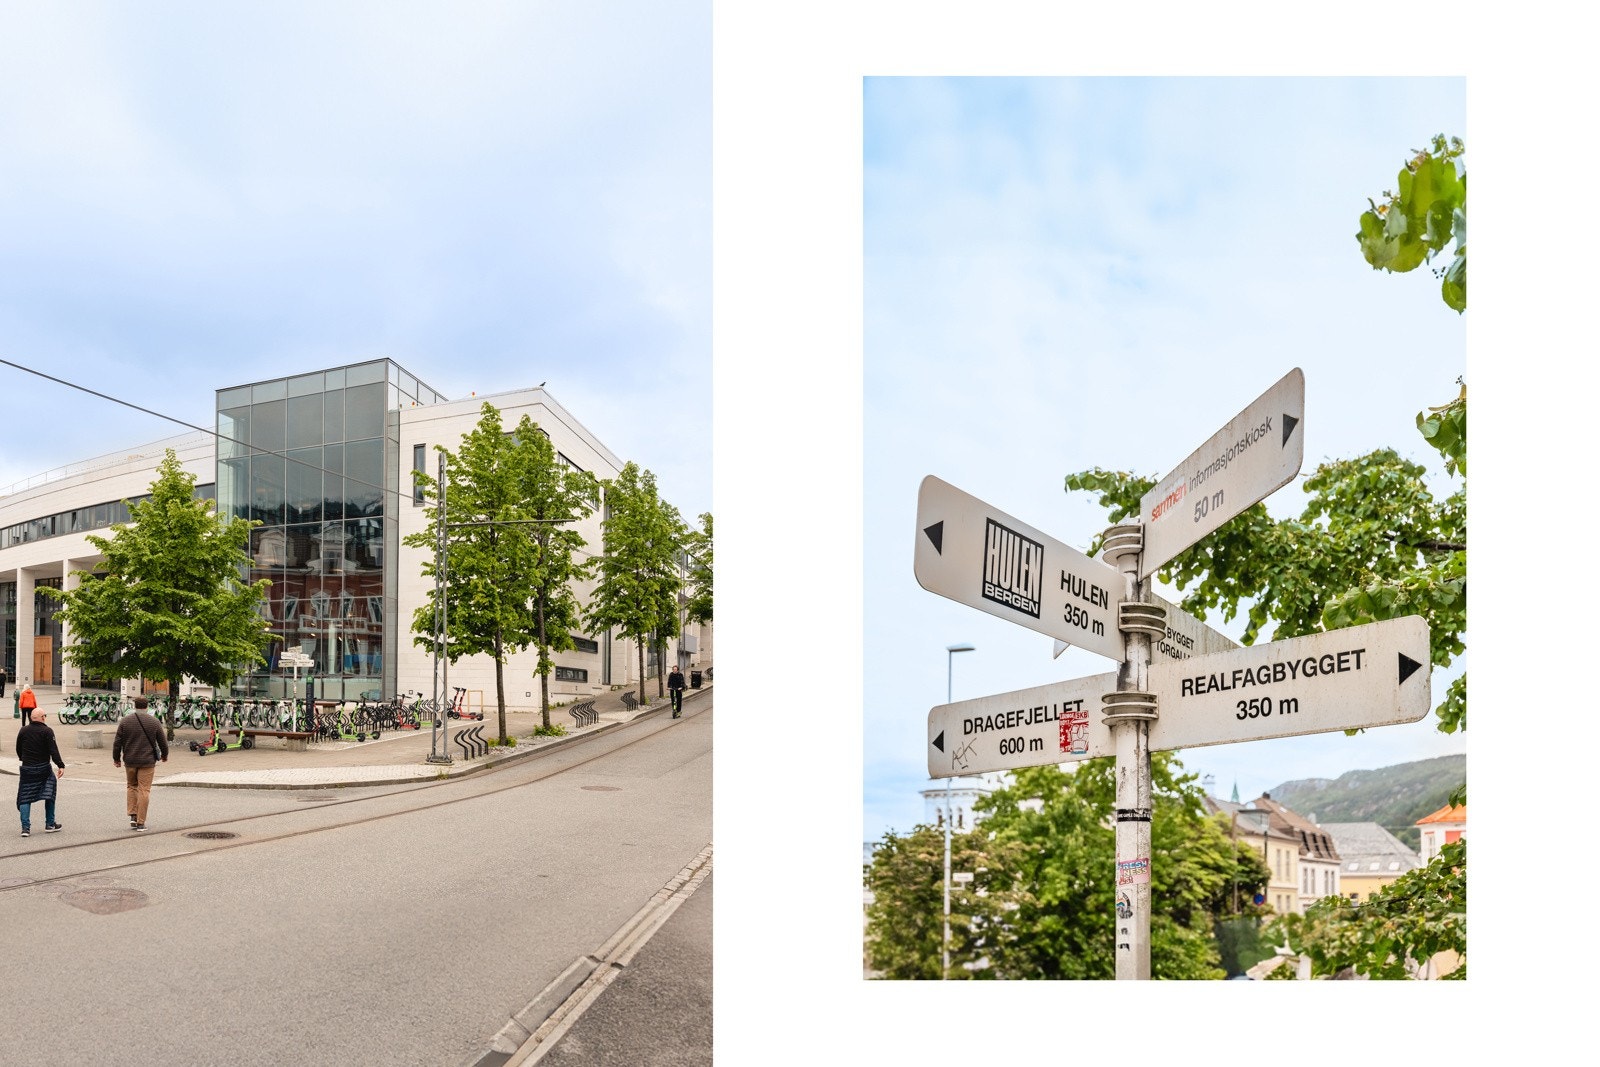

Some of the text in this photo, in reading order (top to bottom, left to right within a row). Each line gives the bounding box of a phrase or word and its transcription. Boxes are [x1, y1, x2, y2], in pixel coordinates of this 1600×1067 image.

[1151, 416, 1273, 522] sammen informasjonskiosk
[1193, 489, 1224, 523] 50 m
[985, 523, 1042, 602] HULEN
[984, 582, 1039, 615] BERGEN
[1060, 569, 1109, 610] HULEN
[1063, 604, 1104, 636] 350 m
[1167, 627, 1194, 650] BYGGET
[1181, 648, 1366, 697] REALFAGBYGGET
[963, 699, 1084, 735] DRAGEFJELLET
[1236, 697, 1299, 720] 350 m
[999, 737, 1044, 755] 600 m
